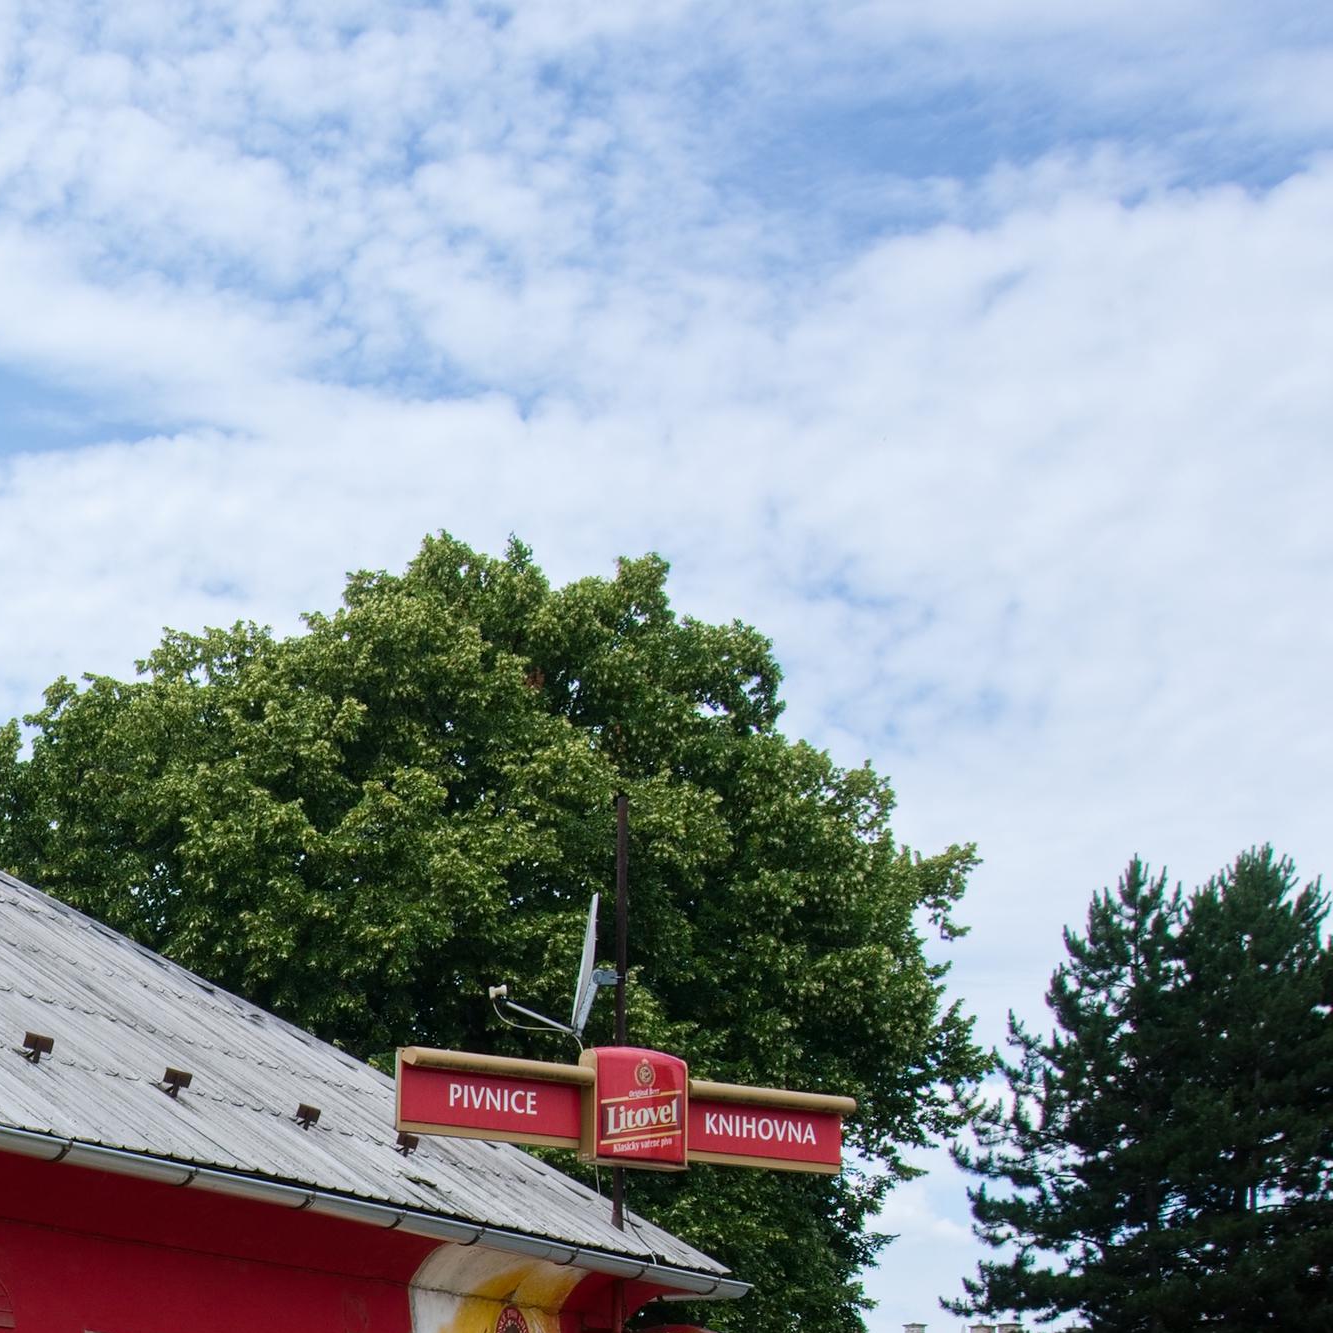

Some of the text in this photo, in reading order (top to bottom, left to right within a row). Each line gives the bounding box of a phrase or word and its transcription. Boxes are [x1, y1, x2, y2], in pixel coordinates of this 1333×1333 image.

[449, 1083, 538, 1115] PIVNICE
[606, 1098, 678, 1135] Litovel
[705, 1112, 817, 1145] KNIHOVNA
